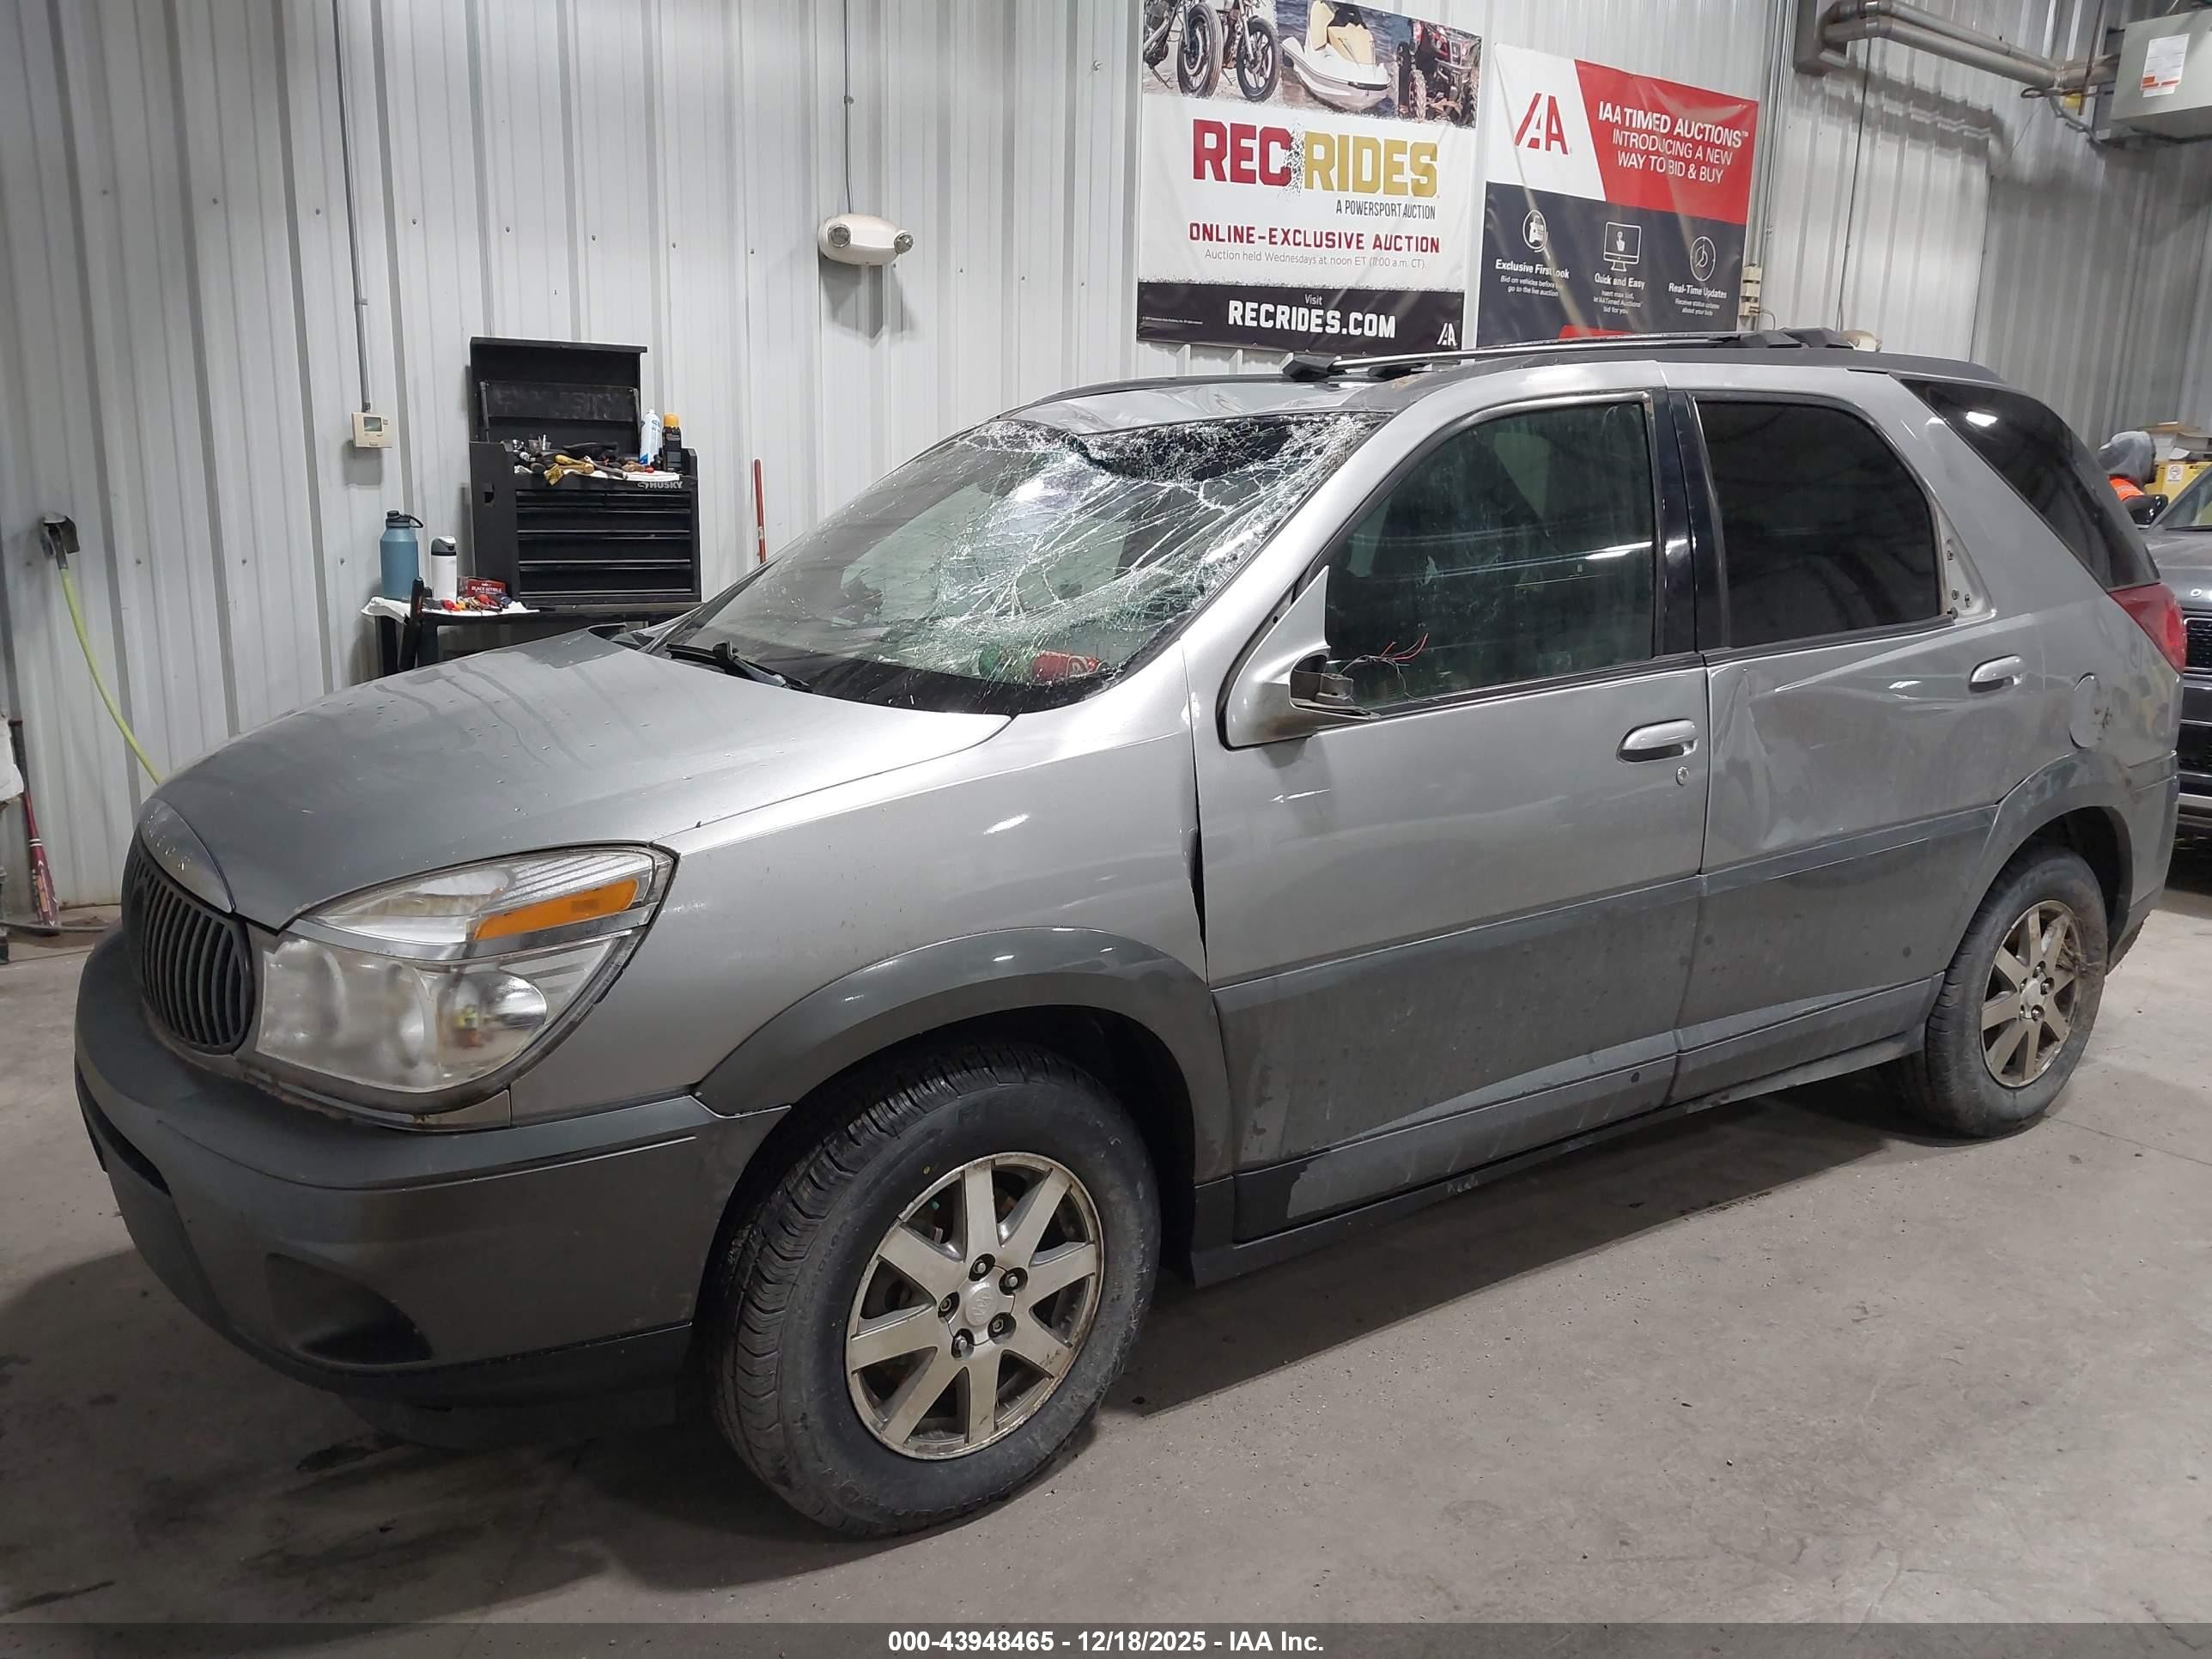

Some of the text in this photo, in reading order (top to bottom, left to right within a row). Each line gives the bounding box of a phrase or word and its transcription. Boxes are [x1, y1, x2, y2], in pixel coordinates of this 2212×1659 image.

[1598, 100, 1621, 125] IAA
[1623, 107, 1671, 134] TIMED
[1193, 118, 1438, 198] REC RIDES
[1613, 128, 1733, 166] INTRODUCING A NEW
[1618, 150, 1724, 184] WAY TO BID & BUY
[1335, 199, 1436, 220] A POWERSPORT AUCTION
[1189, 222, 1440, 253] ONLINE-EXCLUSIVE AUCTION
[1205, 249, 1240, 260] Auction
[1243, 251, 1262, 261] held
[1265, 252, 1316, 265] Wednesdays
[1318, 257, 1327, 265] at
[1330, 257, 1352, 265] noon
[1355, 257, 1366, 265] ET
[1495, 258, 1534, 274] Exclusive
[1595, 272, 1645, 290] Quick and Easy
[1668, 282, 1728, 299] Real-Time Updates
[1304, 294, 1322, 305] Visit
[1228, 300, 1395, 338] RECRIDES.COM
